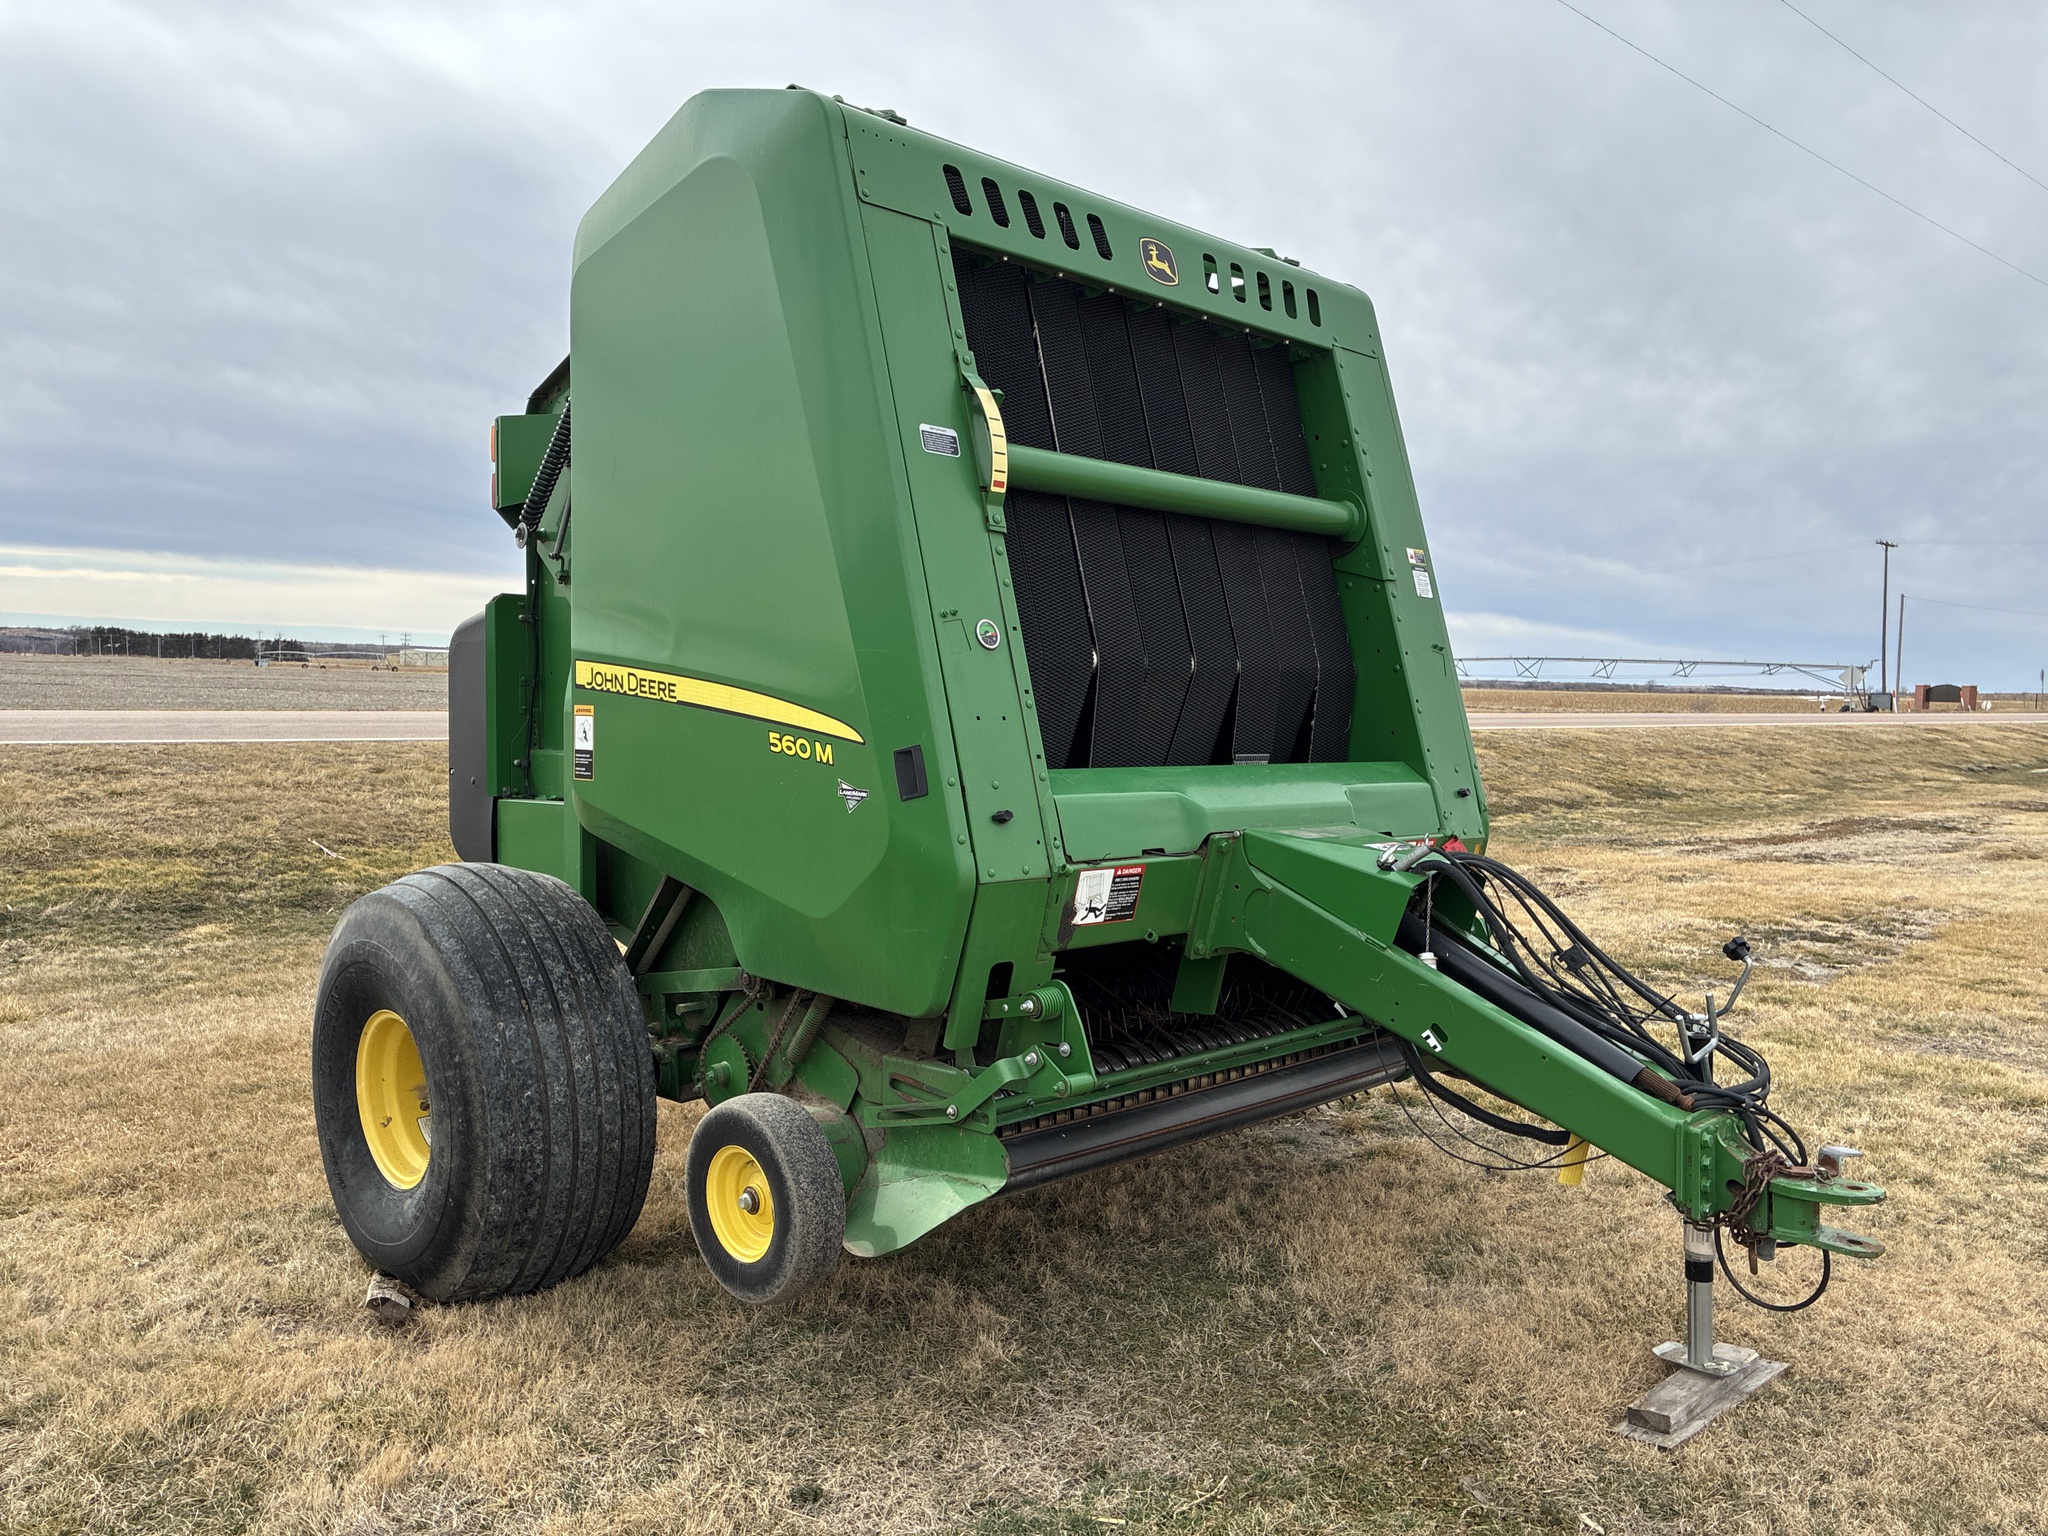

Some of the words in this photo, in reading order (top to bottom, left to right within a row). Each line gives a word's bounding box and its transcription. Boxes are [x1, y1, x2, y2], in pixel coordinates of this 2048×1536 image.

[586, 667, 624, 691] JOHN
[627, 672, 677, 700] DEERE
[768, 731, 811, 760] 560
[814, 740, 834, 766] M
